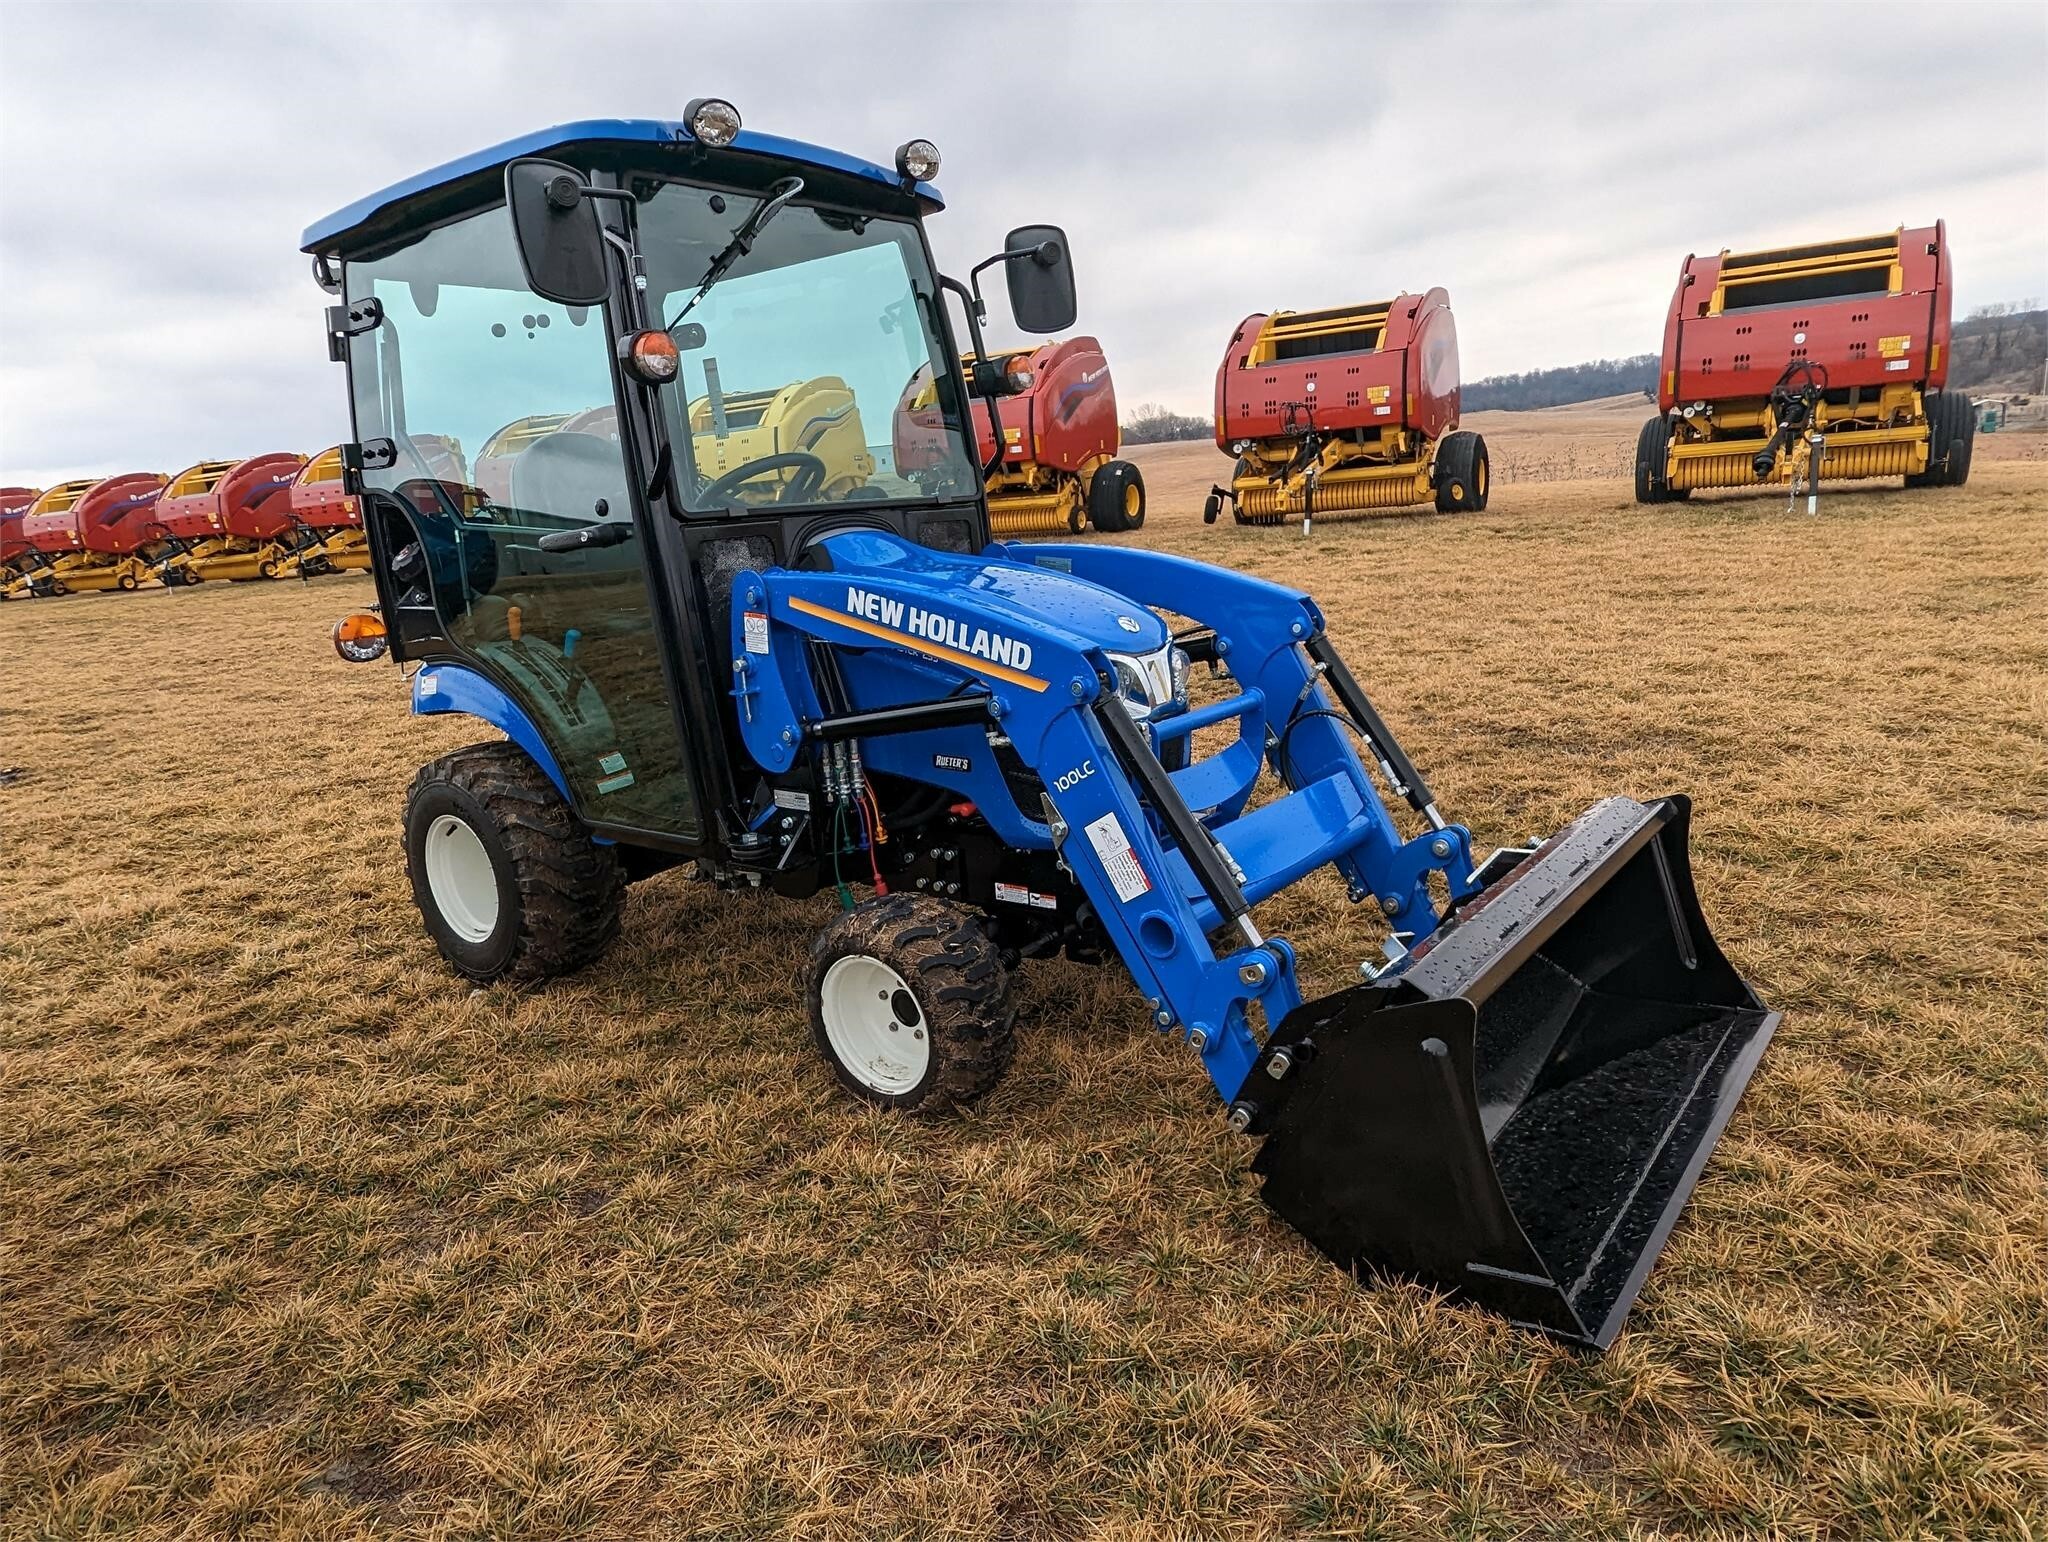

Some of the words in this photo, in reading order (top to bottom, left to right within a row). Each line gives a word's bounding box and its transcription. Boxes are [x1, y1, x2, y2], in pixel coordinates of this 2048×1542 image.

[847, 586, 904, 628] NEW
[908, 606, 1032, 671] HOLLAND
[935, 755, 969, 770] RUETER'S
[1053, 760, 1095, 793] 100LC
